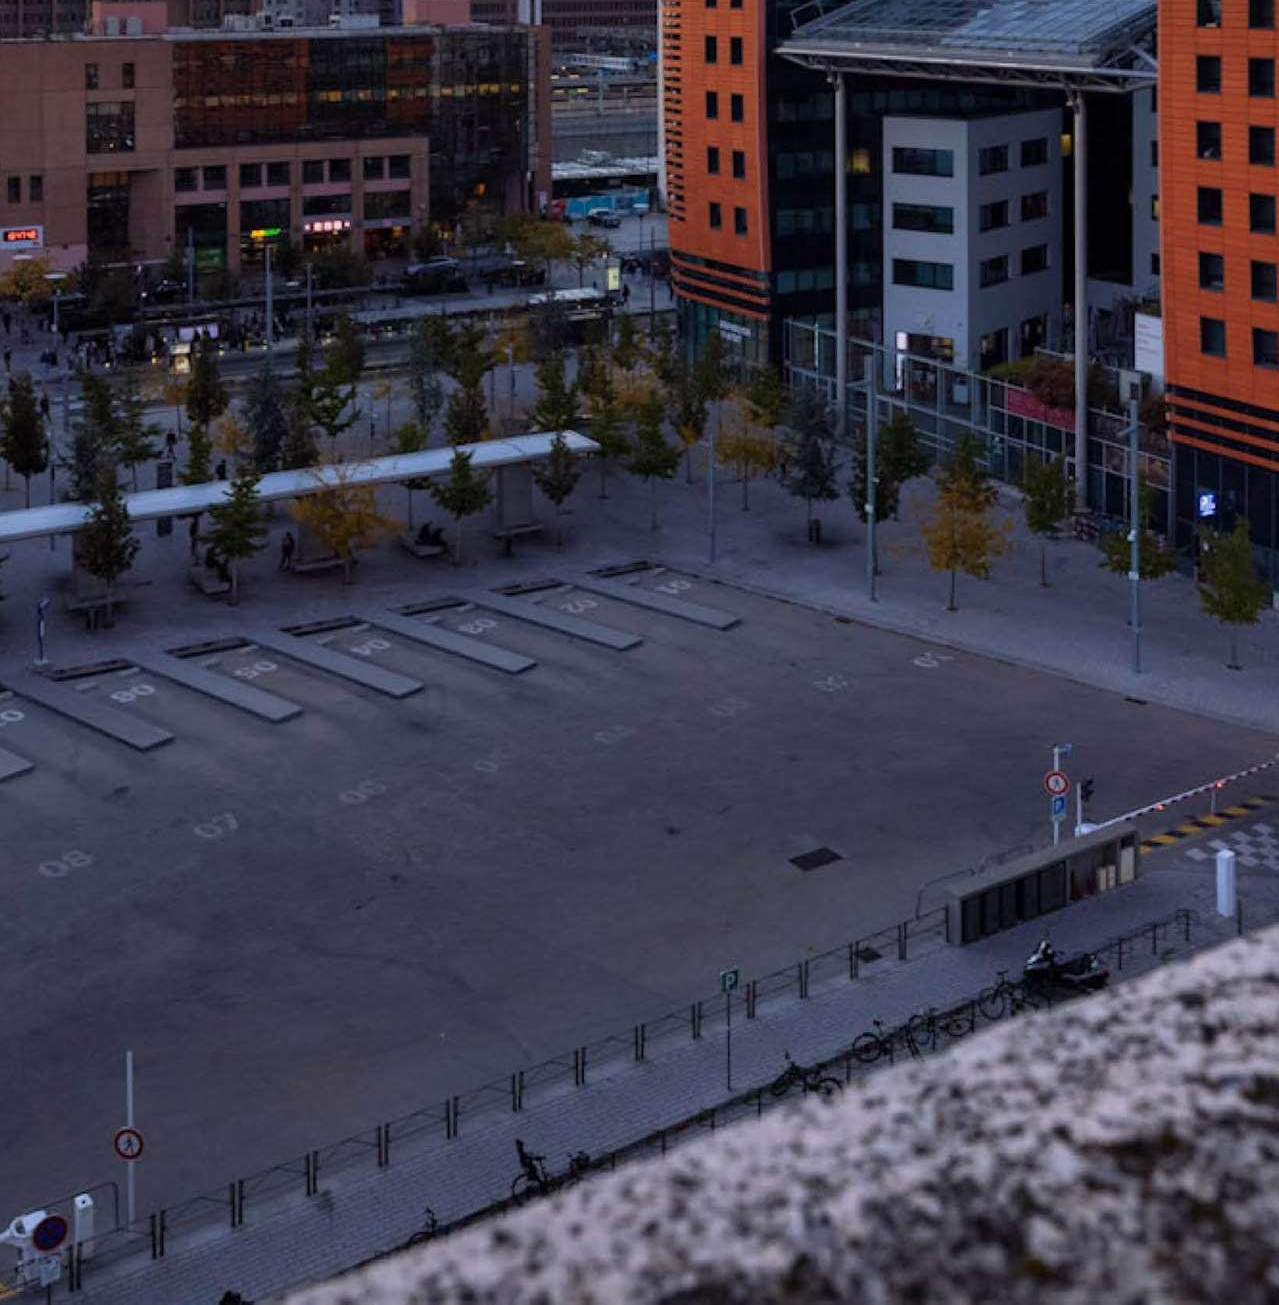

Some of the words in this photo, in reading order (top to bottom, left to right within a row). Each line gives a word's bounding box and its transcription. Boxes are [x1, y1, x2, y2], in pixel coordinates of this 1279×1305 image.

[194, 812, 238, 838] 07
[38, 850, 93, 877] 08
[725, 973, 735, 990] P
